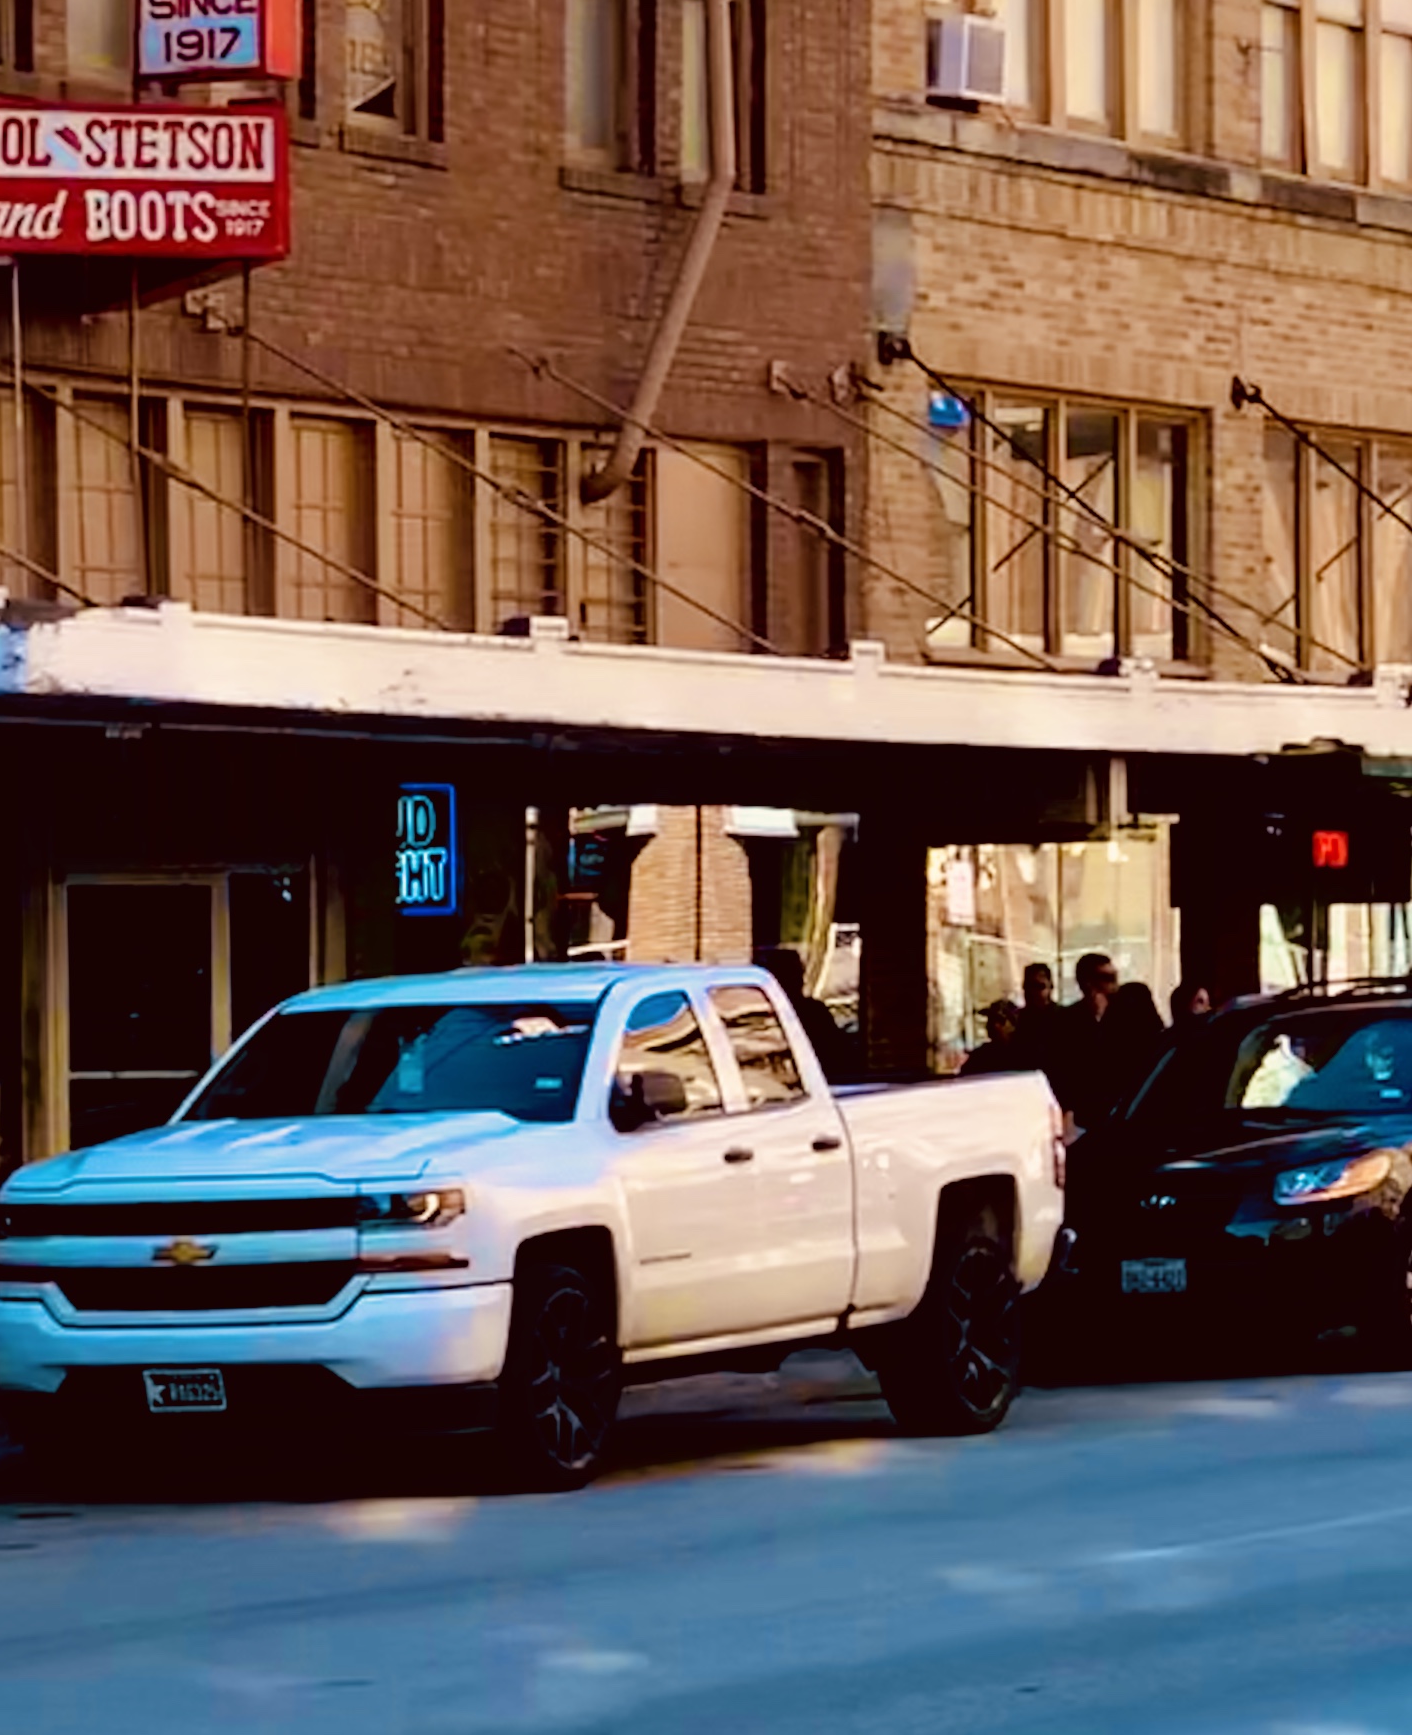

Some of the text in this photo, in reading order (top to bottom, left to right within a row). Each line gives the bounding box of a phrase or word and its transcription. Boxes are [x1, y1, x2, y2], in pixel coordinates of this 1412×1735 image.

[164, 26, 241, 62] 1917
[86, 118, 266, 170] STETSON
[85, 191, 218, 243] BOOTS
[215, 198, 271, 219] SINCE
[224, 218, 265, 238] 1917
